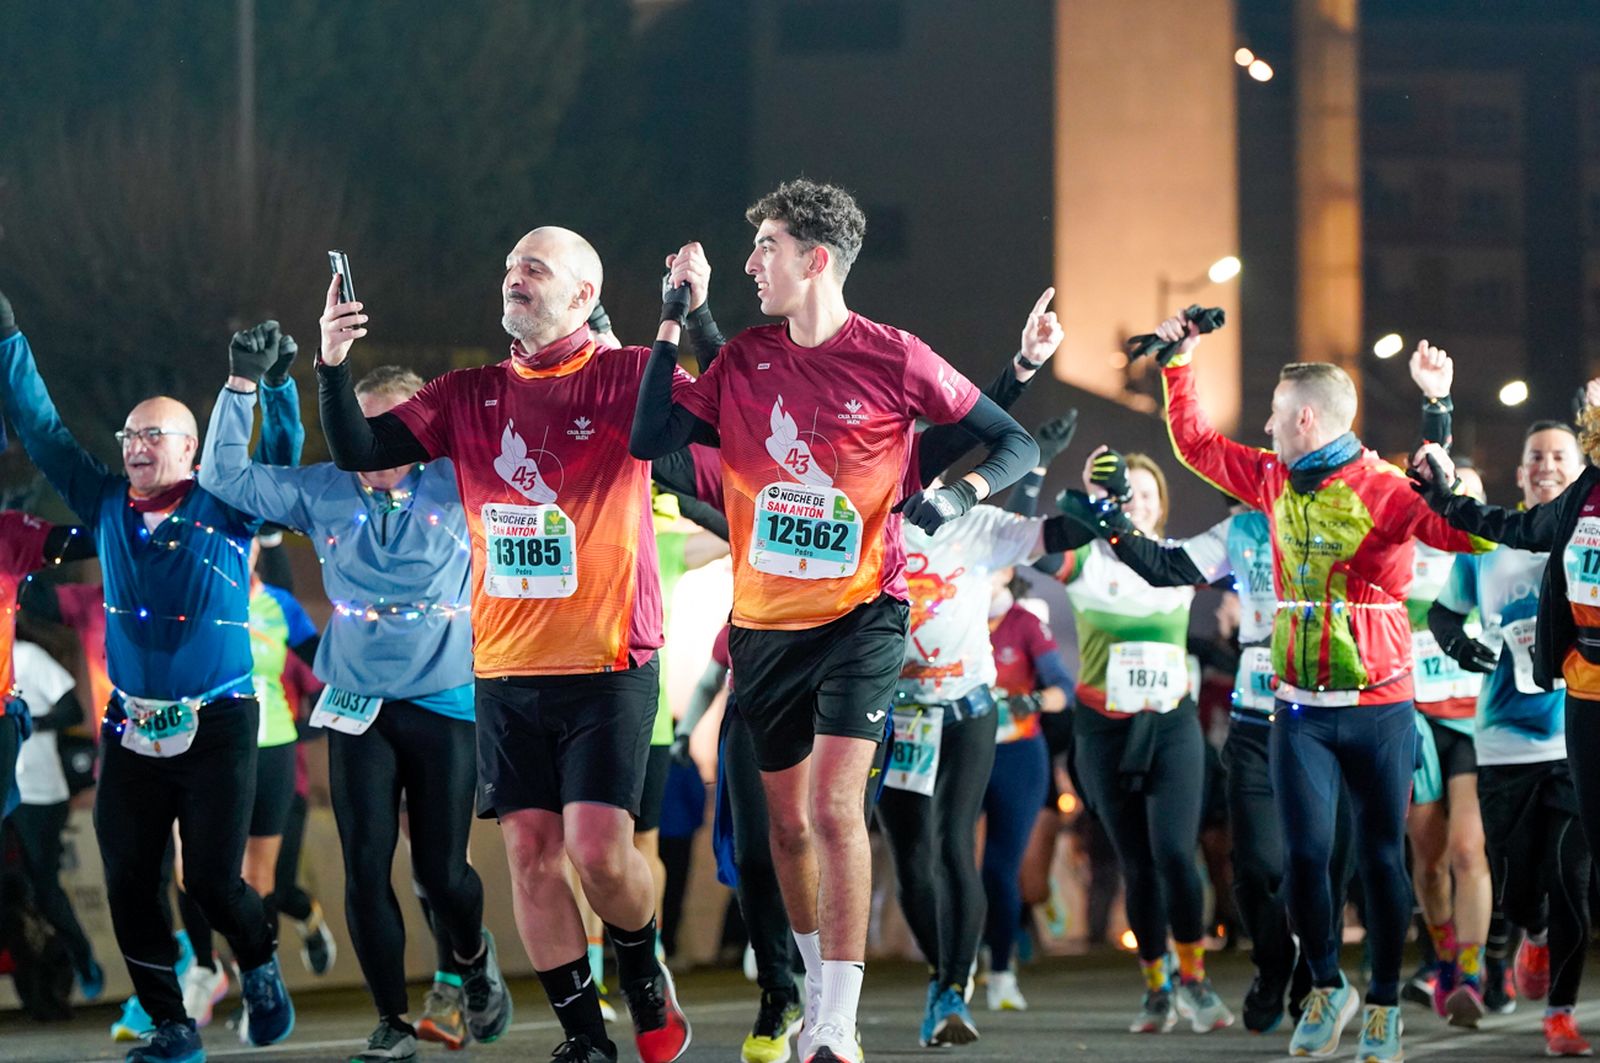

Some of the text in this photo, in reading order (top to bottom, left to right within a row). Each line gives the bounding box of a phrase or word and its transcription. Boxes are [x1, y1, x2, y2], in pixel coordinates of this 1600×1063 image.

[784, 448, 810, 475] 43
[511, 466, 537, 491] 43
[780, 491, 813, 505] NOCHE
[813, 496, 825, 507] DE
[767, 501, 788, 514] SAN
[789, 505, 824, 519] ANTÓN
[498, 514, 526, 526] NOCHE
[527, 516, 538, 526] DE
[492, 526, 505, 536] SAN
[506, 524, 537, 537] ANTÓN
[767, 514, 849, 552] 12562
[494, 538, 562, 567] 13185
[794, 548, 813, 557] Pedro
[515, 568, 533, 576] Pedro
[1129, 669, 1168, 688] 1874
